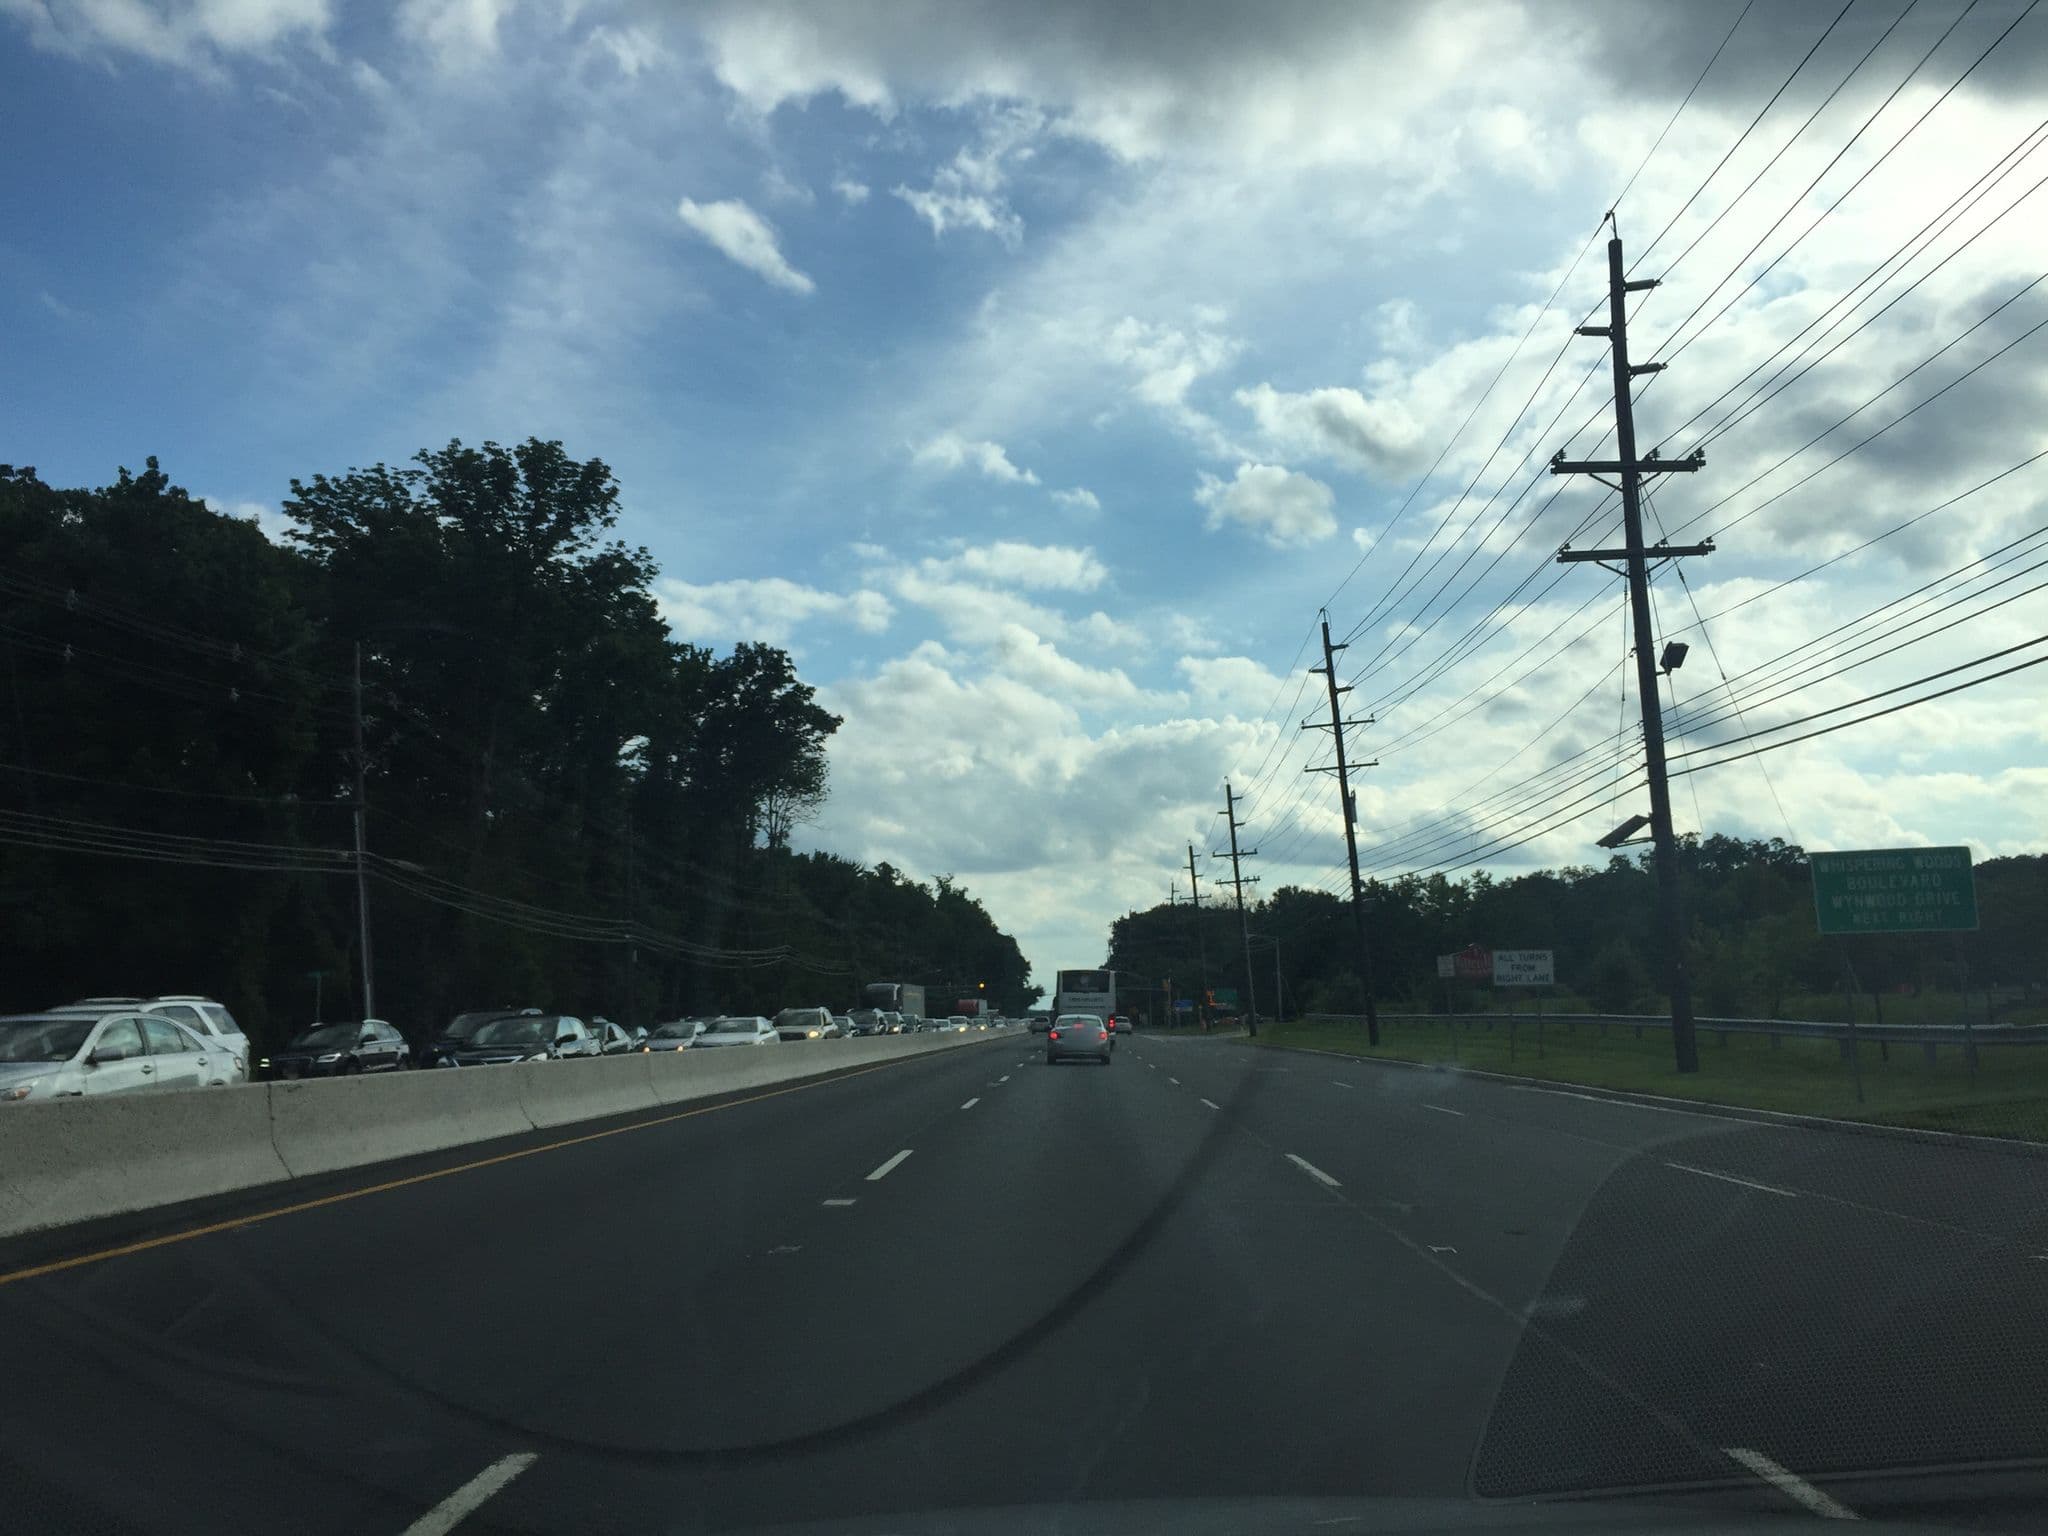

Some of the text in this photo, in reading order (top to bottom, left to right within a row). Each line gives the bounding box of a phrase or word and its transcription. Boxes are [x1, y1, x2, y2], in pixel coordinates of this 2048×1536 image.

[1847, 872, 1942, 889] BOULEVARD
[1915, 891, 1960, 905] DRIVE
[1498, 952, 1548, 962] ALL TURNS
[1496, 974, 1550, 983] RIGHT LANE
